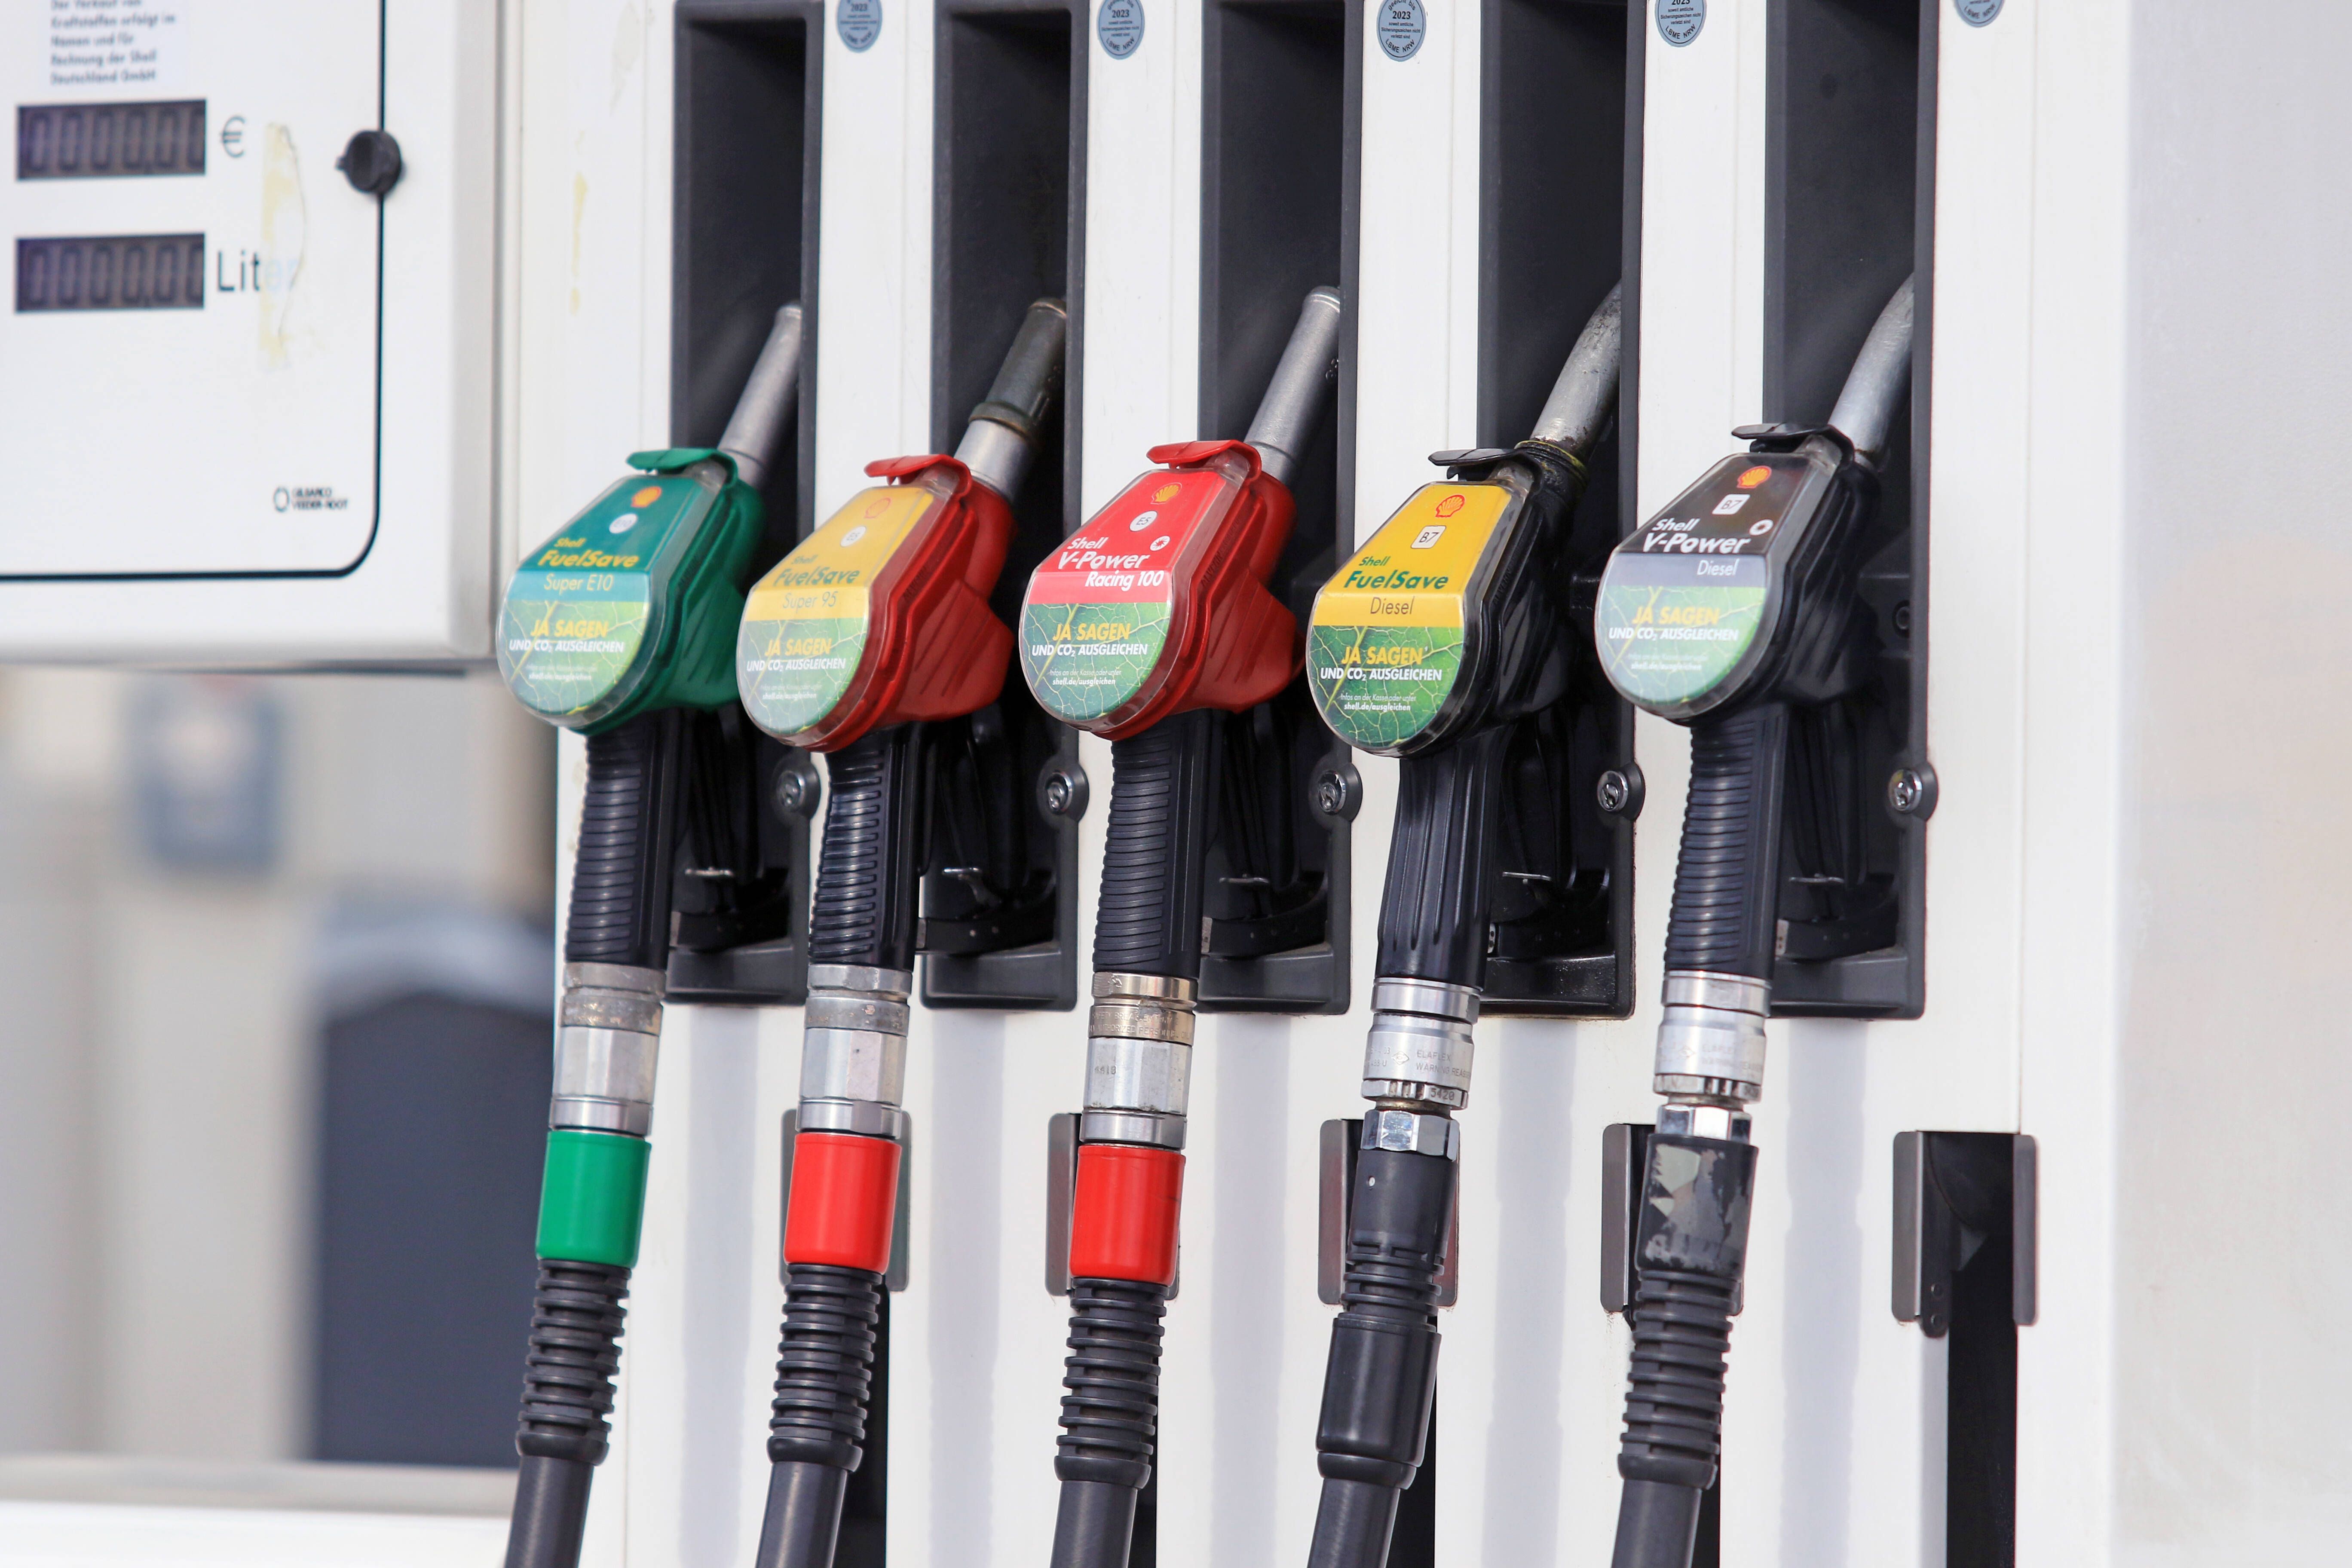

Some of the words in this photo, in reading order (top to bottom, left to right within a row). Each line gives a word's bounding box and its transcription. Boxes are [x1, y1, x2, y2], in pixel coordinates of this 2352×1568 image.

[1112, 9, 1130, 18] 2023
[1393, 11, 1411, 19] 2023
[1666, 25, 1681, 39] LBME
[1683, 24, 1696, 38] NRW
[1385, 38, 1399, 53] LBME
[1402, 40, 1415, 52] NRW
[1721, 500, 1742, 510] B7
[1136, 517, 1151, 525] E5
[1652, 518, 1700, 531] Shell
[554, 538, 586, 547] Shell
[1067, 537, 1109, 549] Shell
[1419, 532, 1439, 543] B7
[1643, 532, 1752, 554] V-Power
[538, 549, 640, 567] FuelSave
[791, 554, 818, 564] Shell
[1058, 551, 1151, 570] V-Power
[1359, 556, 1391, 566] Shell
[1697, 558, 1740, 576] Diesel
[772, 566, 860, 587] FuelSave
[1085, 570, 1135, 592] Racing
[1137, 570, 1164, 587] 100
[1344, 570, 1449, 589] FuelSave
[544, 573, 584, 596] Super
[587, 573, 614, 591] E10
[783, 593, 817, 613] Super
[822, 591, 838, 607] 95
[1370, 596, 1415, 615] Diesel
[1632, 606, 1653, 624] JA
[1658, 606, 1720, 625] SAGEN
[530, 619, 550, 637] JA
[554, 619, 609, 637] SAGEN
[1052, 623, 1072, 641] JA
[1076, 623, 1131, 640] SAGEN
[1608, 627, 1634, 639] UND
[1660, 628, 1739, 641] AUSGLEICHEN
[509, 640, 531, 651] UND
[555, 640, 625, 652] AUSGLEICHEN
[765, 639, 781, 656] JA
[785, 638, 832, 656] SAGEN
[1032, 645, 1054, 656] UND
[1078, 643, 1148, 655] AUSGLEICHEN
[1341, 646, 1361, 665] JA
[747, 660, 765, 671] UND
[785, 658, 846, 670] AUSGLEICHEN
[1320, 668, 1344, 679] UND
[1369, 668, 1442, 681] AUSGLEICHEN
[1052, 677, 1116, 686] shell.de/ausgleichen
[1344, 702, 1411, 712] shell.de/ausgleichen
[1417, 1049, 1452, 1062] ELAFLEX
[1416, 1063, 1450, 1075] WARNING
[1430, 1088, 1455, 1101] 5420
